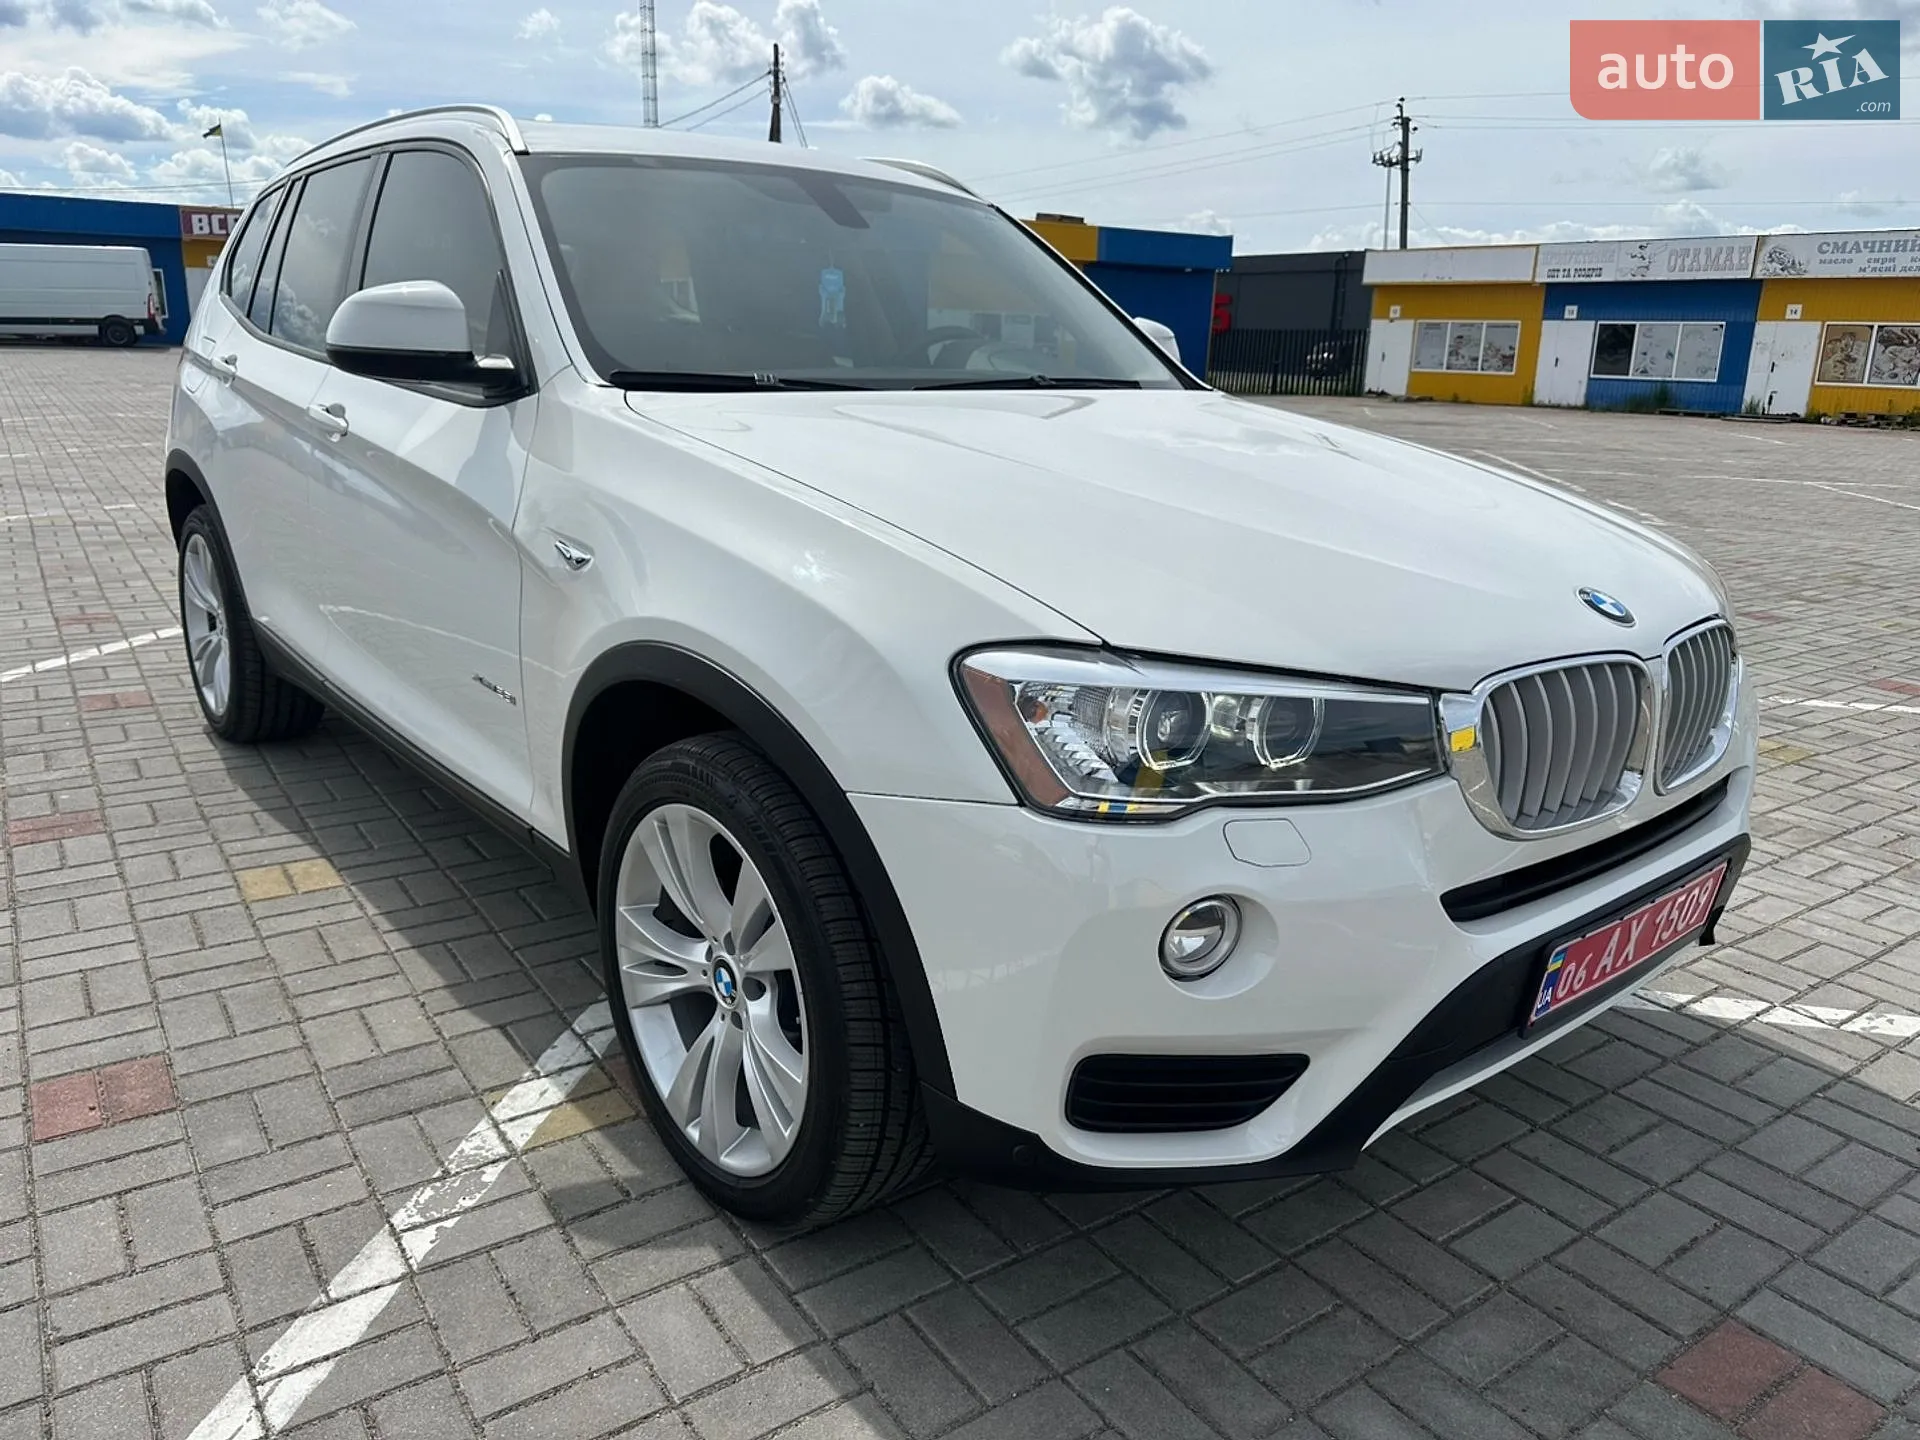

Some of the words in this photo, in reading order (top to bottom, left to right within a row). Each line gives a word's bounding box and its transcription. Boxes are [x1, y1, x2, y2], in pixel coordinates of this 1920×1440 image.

[1667, 245, 1753, 273] ОТАМАН
[1556, 952, 1593, 1000] 06
[1593, 912, 1650, 980] AX
[1651, 877, 1714, 948] 1509
